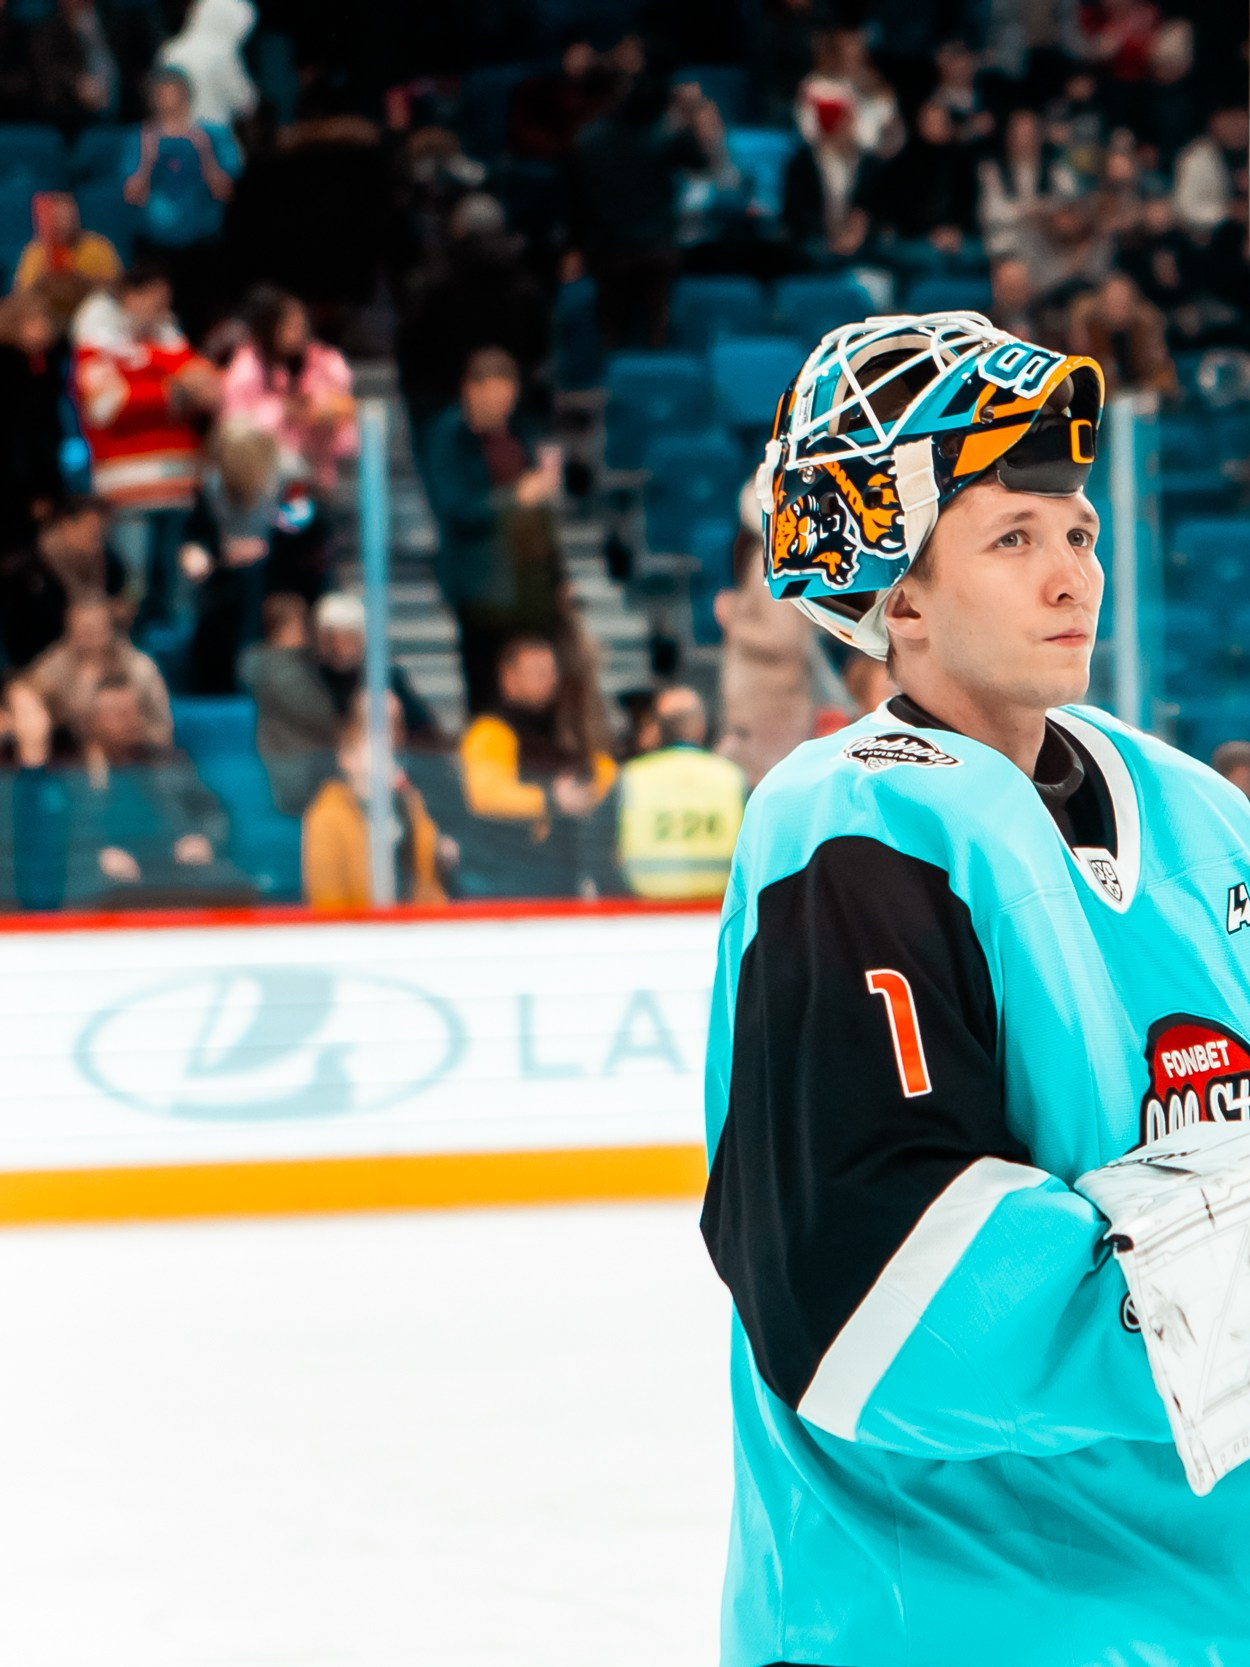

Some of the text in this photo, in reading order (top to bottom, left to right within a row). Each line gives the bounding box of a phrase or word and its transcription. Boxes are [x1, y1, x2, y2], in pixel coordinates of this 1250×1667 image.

[517, 985, 713, 1080] LA
[865, 968, 933, 1098] 1
[1161, 1040, 1230, 1078] FONBET
